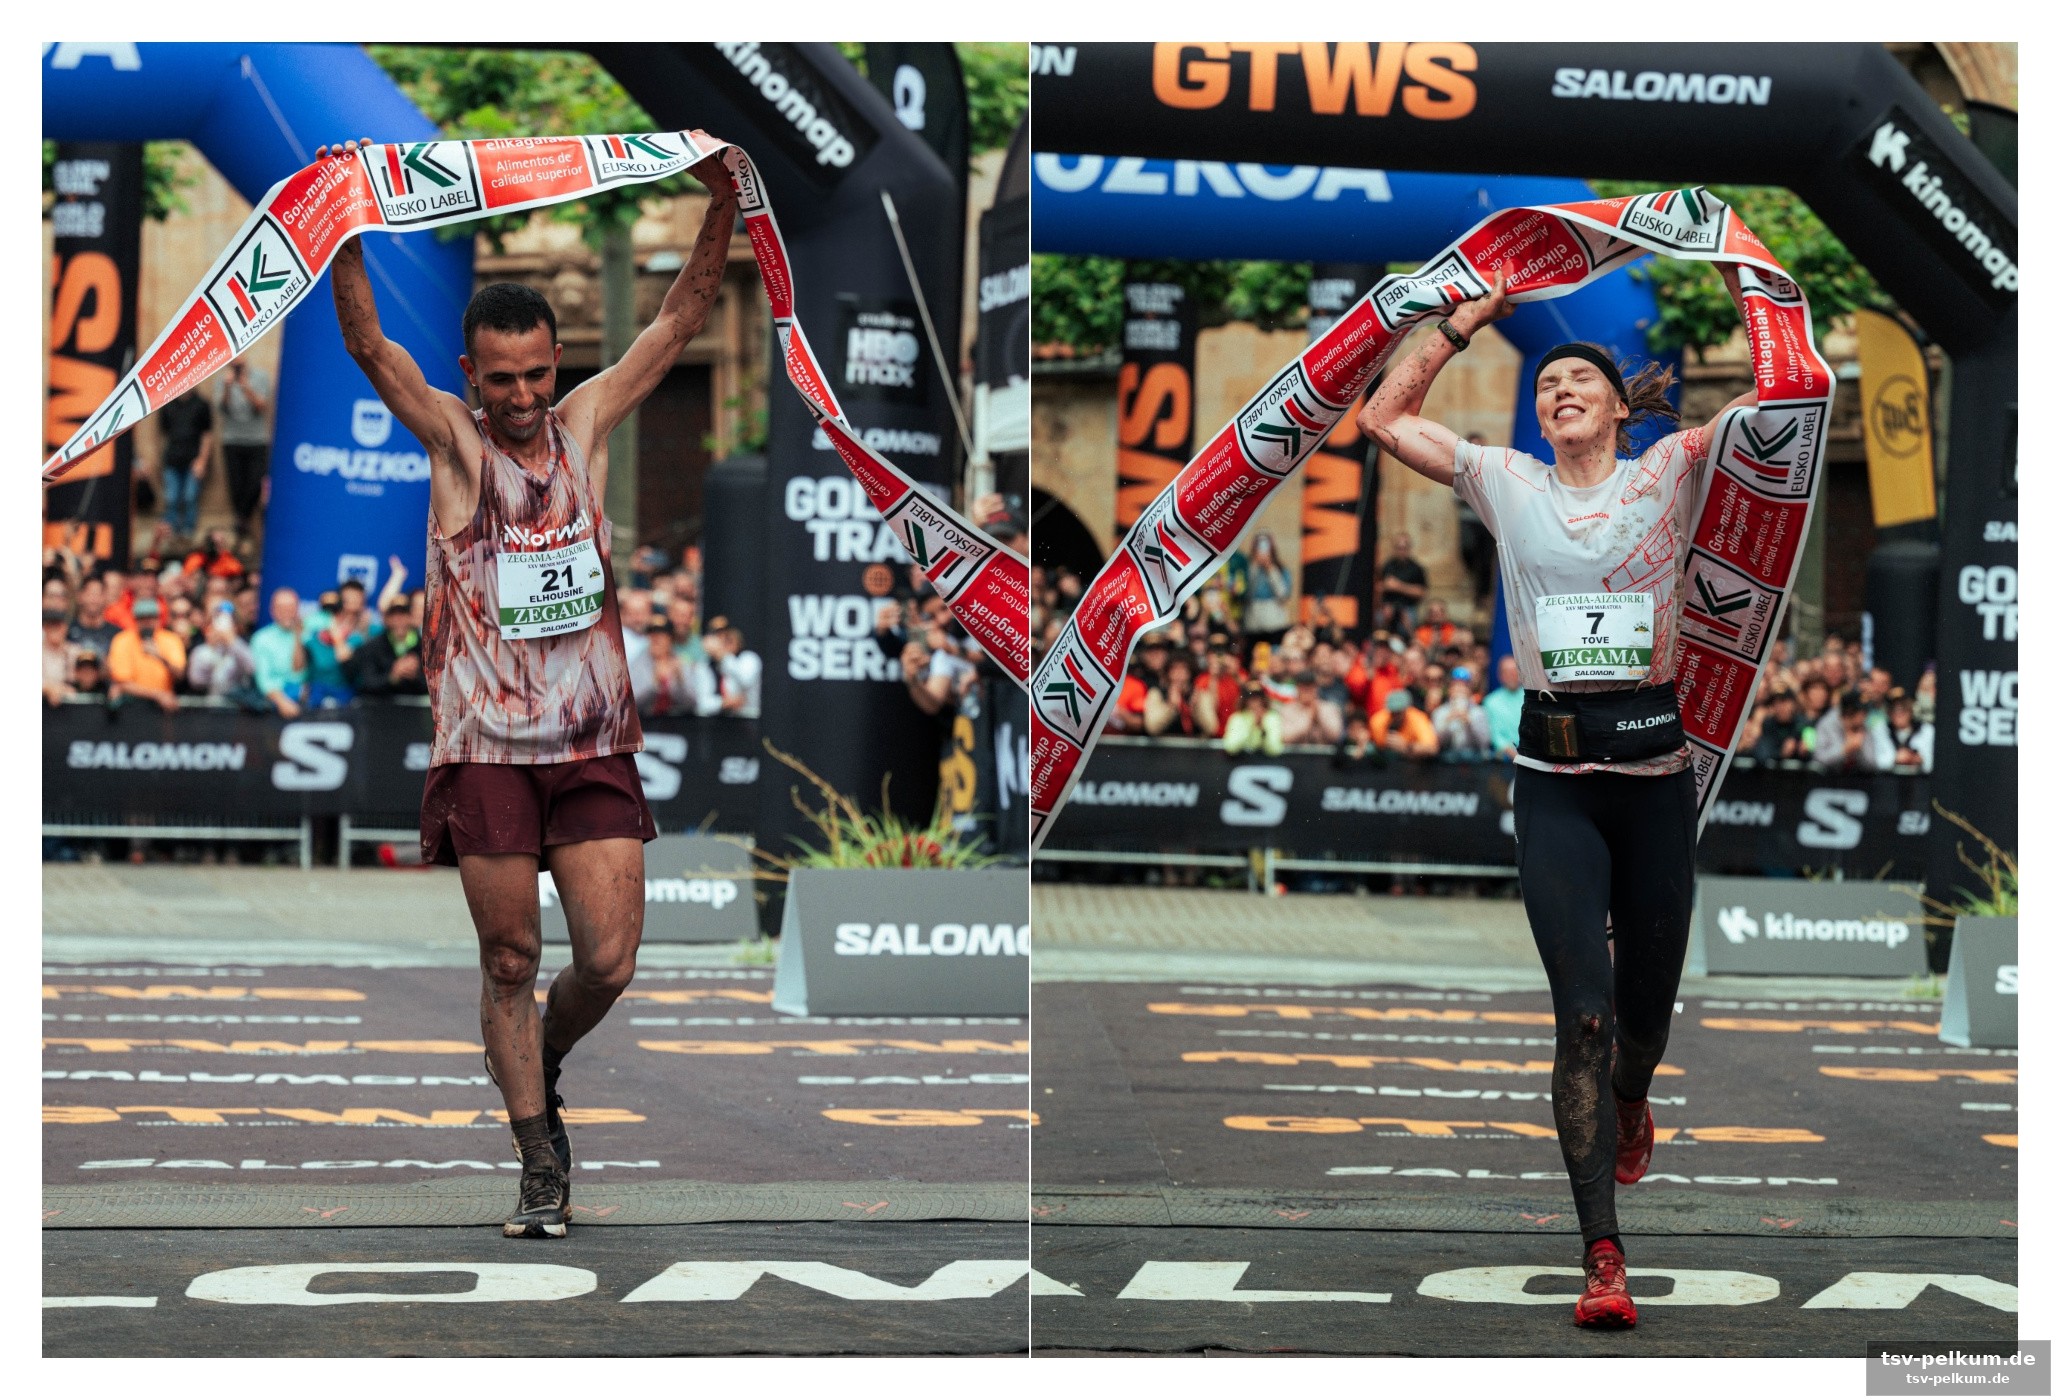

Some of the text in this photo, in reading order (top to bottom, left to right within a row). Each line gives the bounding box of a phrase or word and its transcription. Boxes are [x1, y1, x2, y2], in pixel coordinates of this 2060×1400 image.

[1152, 42, 1478, 121] GTWS
[1551, 67, 1773, 105] SALOMON
[491, 165, 584, 189] calidad superior
[496, 152, 573, 173] Alimentos de
[602, 155, 690, 174] EUSKO LABEL
[737, 159, 756, 204] EUSKO
[296, 166, 354, 231] elikagaiak
[307, 186, 363, 244] Alimentos de
[385, 189, 474, 217] EUSKO LABEL
[309, 198, 374, 258] calidad superior
[753, 221, 778, 266] superior
[1474, 211, 1545, 265] calidad superior
[1503, 225, 1550, 262] Alimentos
[1631, 211, 1714, 244] EUSKO LABEL
[1734, 230, 1766, 250] calida
[1902, 160, 2018, 292] kinomap
[1379, 279, 1420, 307] LABEL
[1418, 262, 1461, 286] EUSKO
[240, 275, 305, 345] EUSKO LABEL
[1780, 310, 1801, 352] superior
[145, 312, 213, 388] Goi-mailako
[848, 327, 920, 364] HBO
[1341, 318, 1374, 348] calidad
[1751, 306, 1776, 389] elikagaiak
[1781, 327, 1799, 383] Alimentos
[155, 329, 214, 392] elikagaiak
[163, 359, 207, 401] Alimentos
[207, 347, 219, 360] de
[788, 341, 828, 411] oi-mailak
[846, 360, 915, 388] max
[1310, 343, 1344, 376] superior
[1320, 334, 1377, 383] Alimentos de
[1796, 352, 1814, 390] calidad
[1241, 372, 1300, 431] EUSKO LABEL
[811, 424, 942, 456] SOMON
[1791, 408, 1818, 493] EUSKO LABEL
[857, 465, 891, 498] calidad
[1178, 441, 1234, 496] calidad superior
[1185, 456, 1234, 503] Alimentos de
[1194, 474, 1250, 525] elikagaiak
[1202, 477, 1270, 538] Goi-mailako
[1567, 512, 1610, 524] SALOMON
[1708, 482, 1739, 553] Goi-mailako
[805, 520, 911, 564] TRA
[908, 500, 985, 558] EUSKO LABEL
[1727, 496, 1752, 555] elikagaiak
[1748, 510, 1774, 566] Alimentos de
[1761, 506, 1790, 578] calidad superior
[507, 541, 591, 564] ZEGAMA-AIZKORRI
[529, 586, 584, 603] ELHOUSINE
[540, 565, 574, 593] 21
[987, 581, 1029, 619] entos de
[1080, 566, 1132, 628] calidad superior
[1545, 594, 1646, 607] ZEGAMA-AIZKORRI
[513, 595, 598, 624] ZEGAMA
[540, 621, 579, 633] SALOMON
[968, 599, 1029, 655] likagaiak
[1086, 580, 1128, 632] Alimentos de
[1096, 594, 1137, 651] elikagaiak
[1586, 612, 1605, 635] 7
[1742, 593, 1773, 656] EUSKO LABEL
[1034, 629, 1075, 695] EUSKO LABEL
[1551, 649, 1641, 667] ZEGAMA
[1581, 636, 1610, 645] TOVE
[1693, 663, 1724, 725] Alimentos de
[1706, 662, 1740, 736] calidad superior
[1616, 711, 1677, 731] SALOMON
[1959, 707, 2018, 747] SE
[67, 741, 246, 771] SALOMON
[1066, 780, 1199, 808] ALOMON
[1321, 786, 1479, 817] SALOMON
[1764, 911, 1910, 949] kinomap
